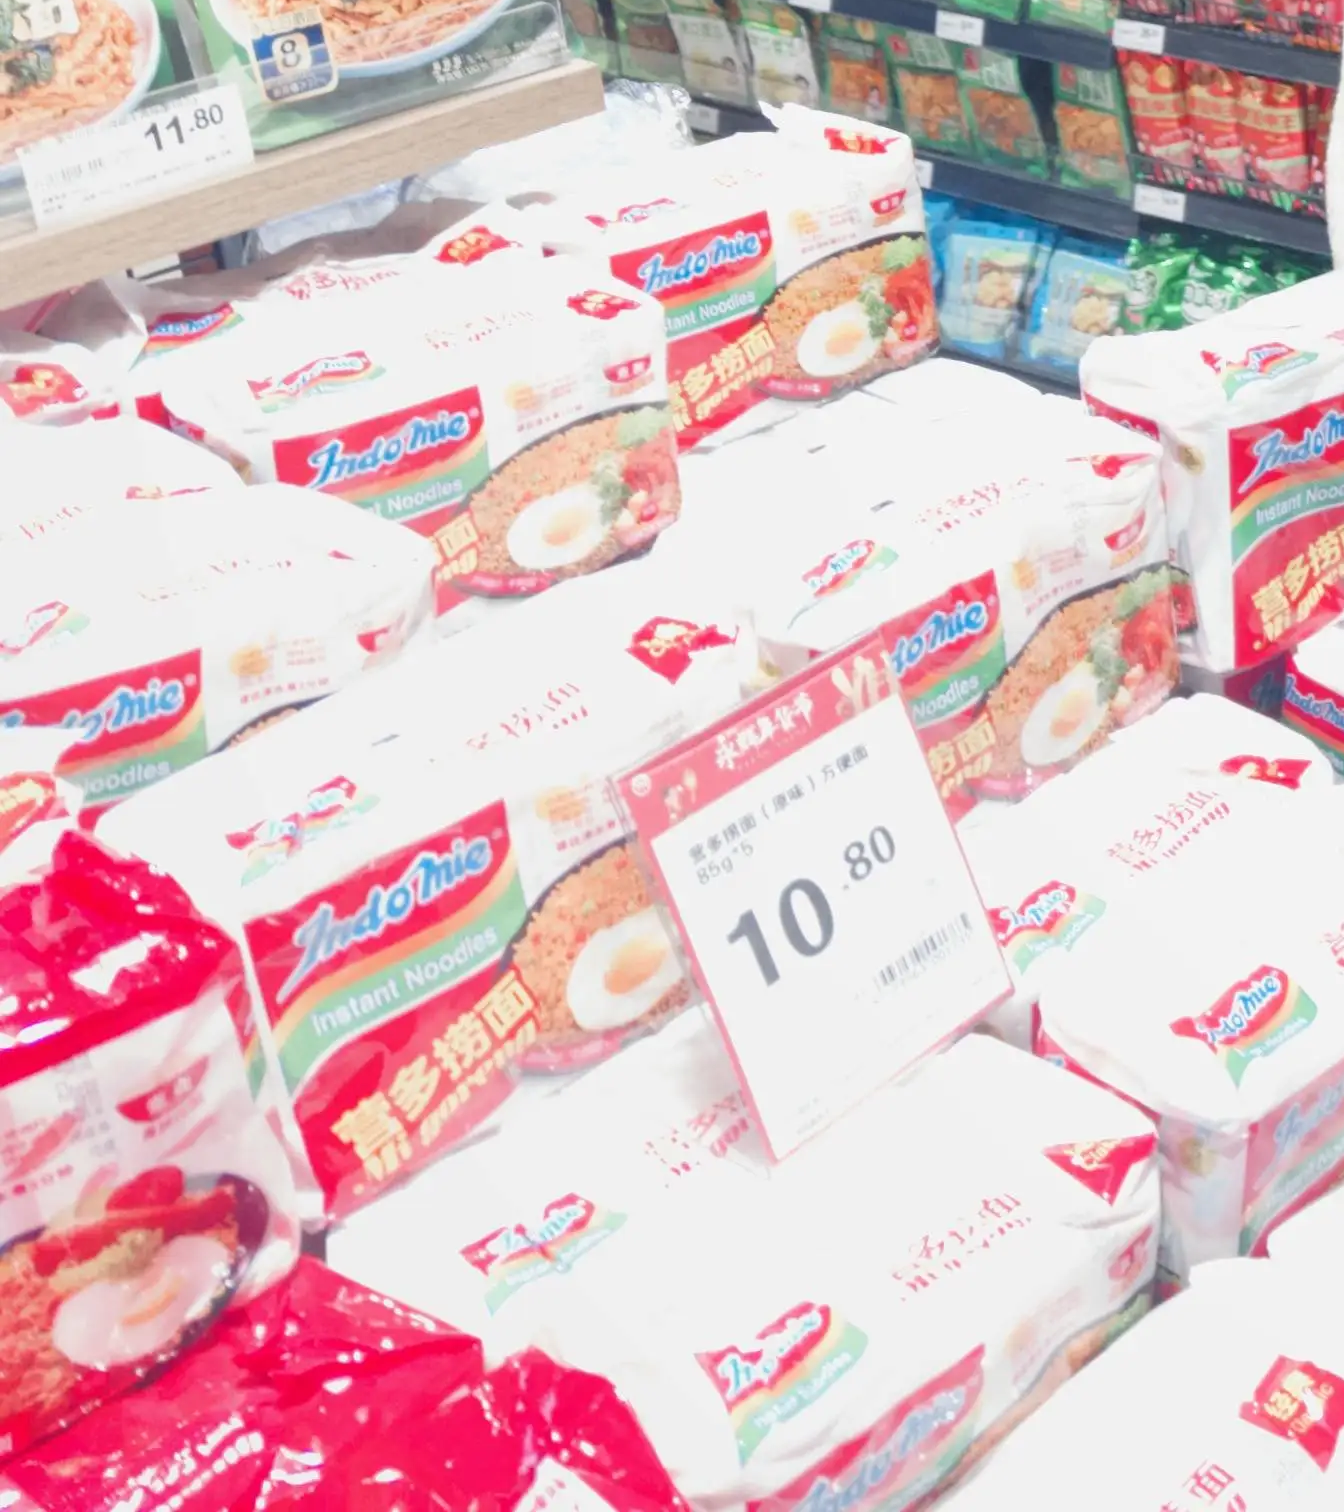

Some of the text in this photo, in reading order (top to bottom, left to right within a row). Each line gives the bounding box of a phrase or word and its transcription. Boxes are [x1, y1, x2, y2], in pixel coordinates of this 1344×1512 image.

[145, 103, 224, 152] 11.80
[638, 232, 760, 294] Indomie
[701, 290, 756, 319] Noodles
[307, 412, 470, 488] Indomie
[387, 476, 462, 514] Noodles
[1257, 495, 1300, 526] Instant
[913, 676, 979, 723] Noodles
[277, 837, 492, 1005] Indomie
[727, 826, 897, 987] 10.80
[312, 926, 499, 1038] Instant Noodles
[331, 973, 534, 1163] 营多捞面
